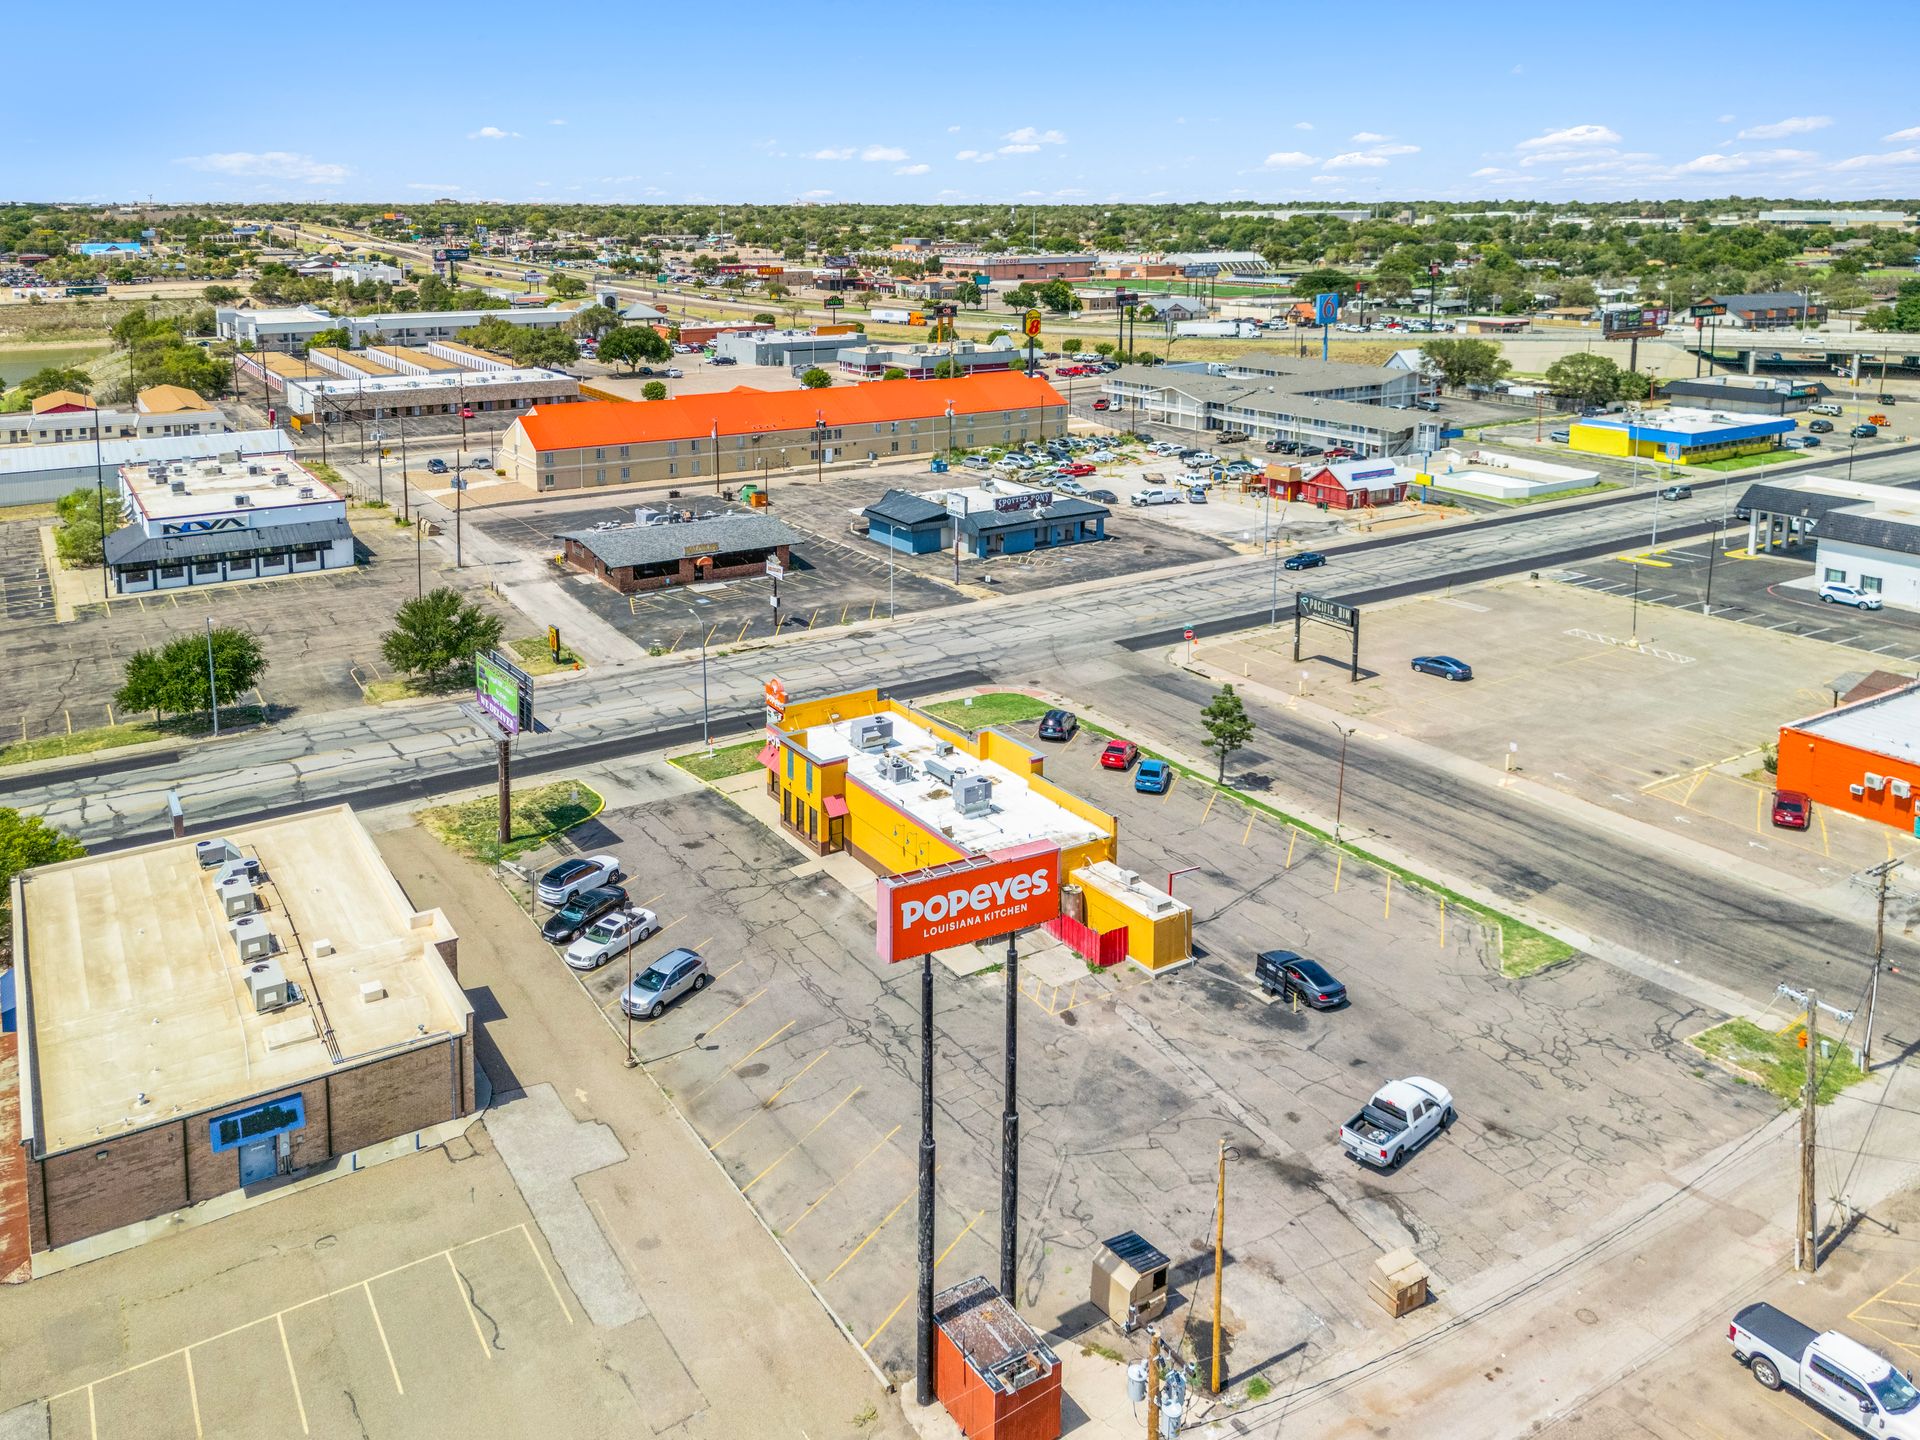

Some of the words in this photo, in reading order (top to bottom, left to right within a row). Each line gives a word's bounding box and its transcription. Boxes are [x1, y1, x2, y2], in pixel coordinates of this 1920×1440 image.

[1323, 296, 1335, 318] 6
[1029, 319, 1040, 335] 8
[998, 496, 1028, 508] SPOTTED
[1031, 493, 1050, 503] PONY
[1310, 598, 1334, 615] PACIFIC
[1338, 606, 1351, 620] RIM
[480, 695, 489, 709] WE
[490, 702, 514, 729] DELIVER
[923, 917, 982, 937] LOUISIANA
[984, 903, 1028, 922] KITCHEN
